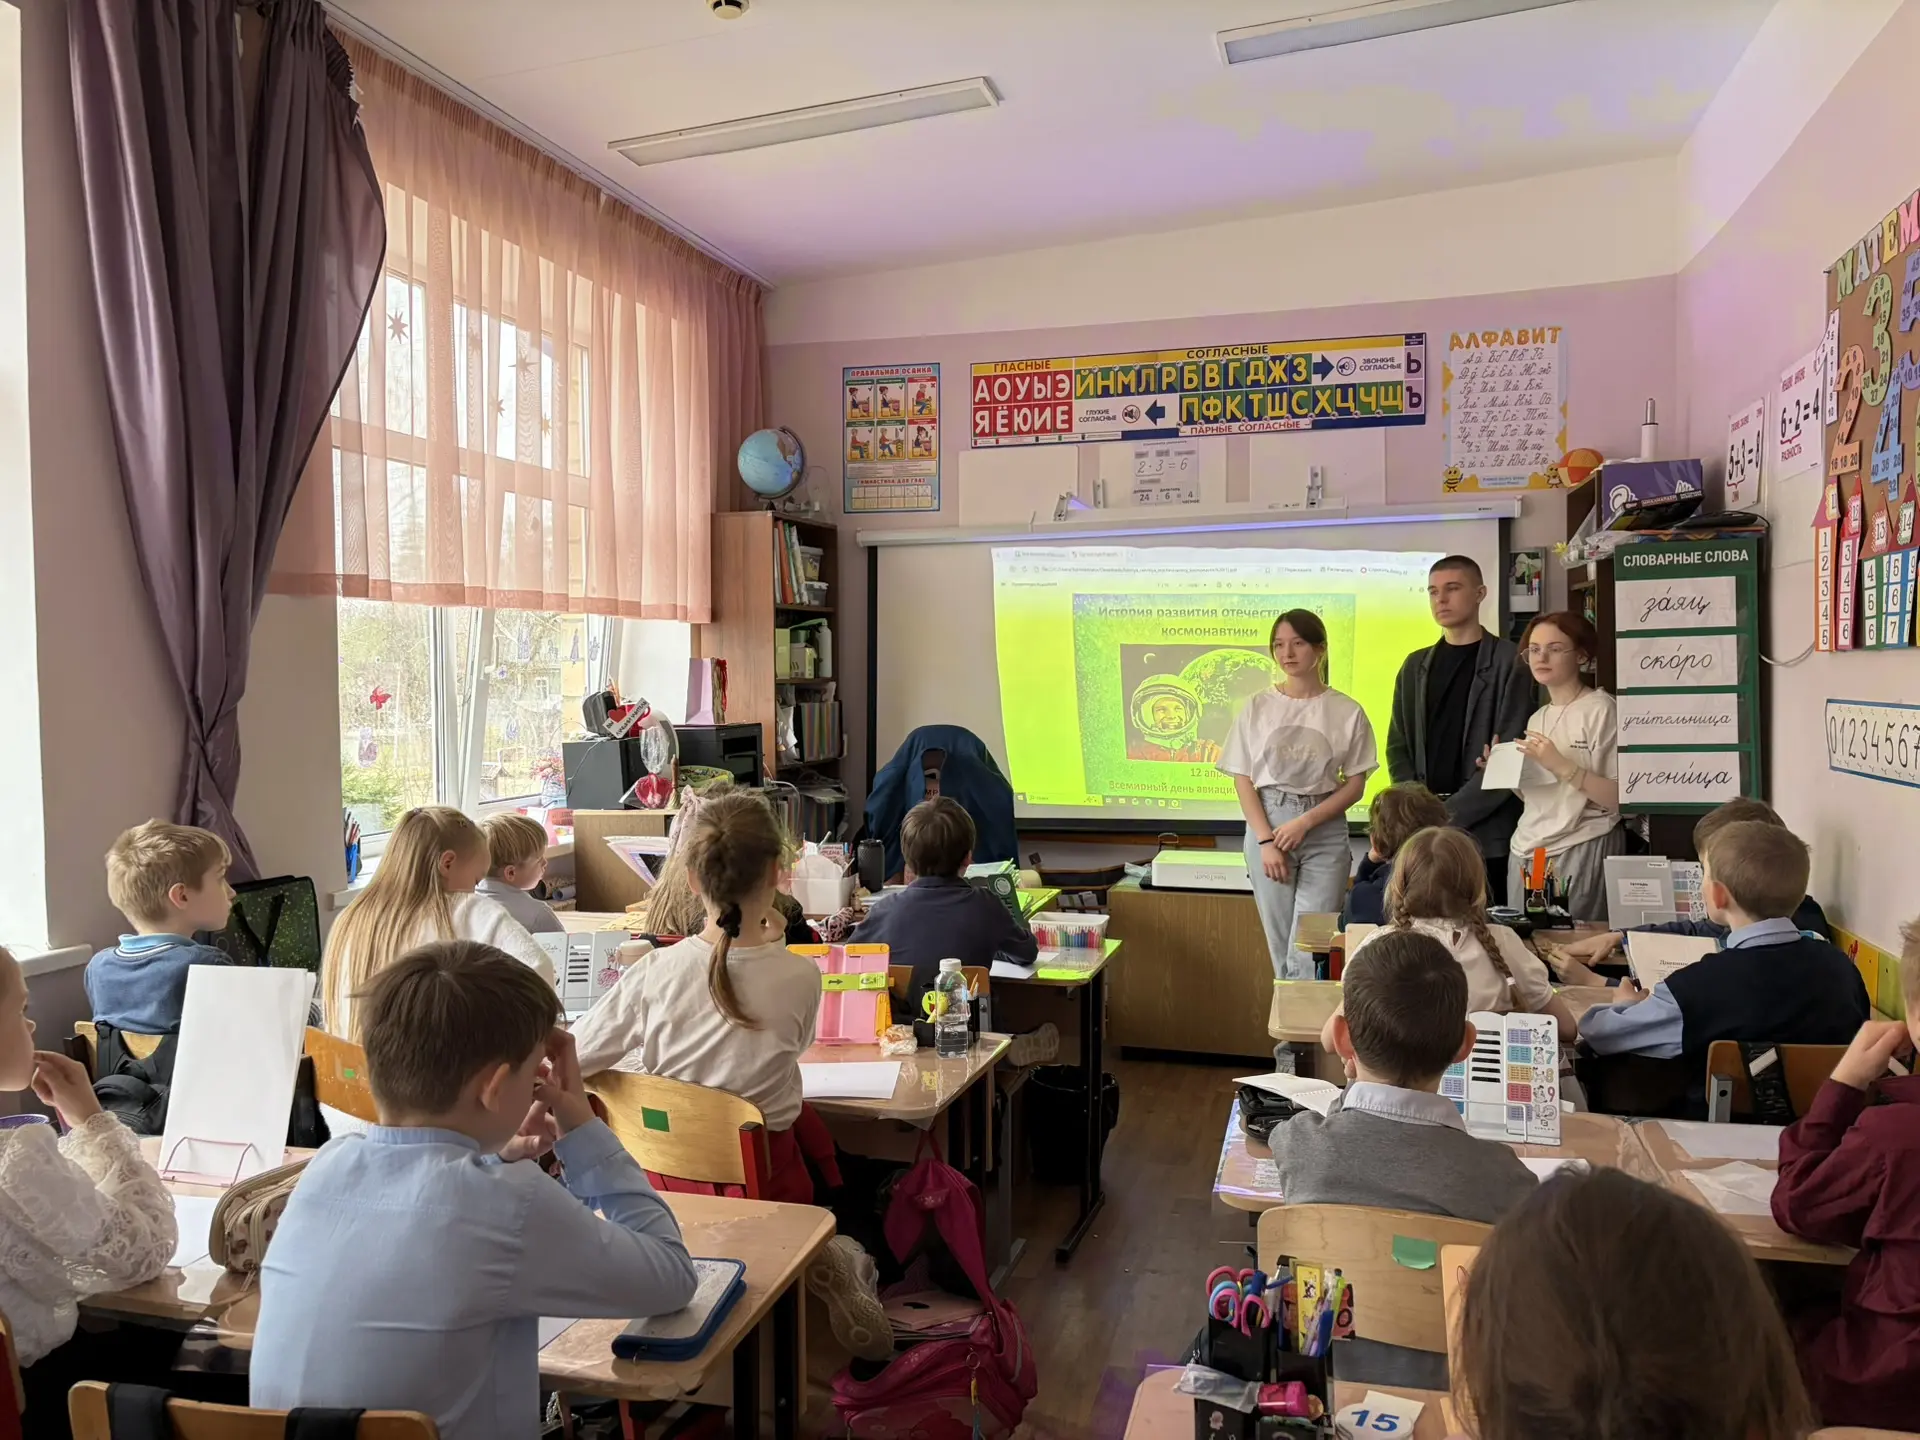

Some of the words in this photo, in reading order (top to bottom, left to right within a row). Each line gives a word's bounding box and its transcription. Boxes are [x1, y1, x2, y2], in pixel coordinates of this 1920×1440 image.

[1836, 190, 1920, 302] МАТЕМ
[1449, 326, 1562, 351] АЛФАВИТ
[1187, 345, 1268, 359] СОГЛАСНЫЕ
[851, 369, 900, 377] ПРАВИЛЬНАЯ
[994, 360, 1051, 373] ГЛАСНЫЕ
[1359, 363, 1402, 371] СОГЛАСНЫЕ
[1079, 414, 1116, 423] СОГЛАСНЫЕ
[1190, 425, 1232, 435] ПАРНЫЕ
[1238, 421, 1300, 432] СОГЛАСНЫЕ
[1903, 512, 1912, 531] 14
[1876, 521, 1885, 541] 13
[1823, 532, 1828, 547] 1
[1623, 552, 1702, 567] СЛОВАРНЫЕ
[1705, 549, 1749, 563] СЛОВА
[1844, 544, 1851, 561] 3
[1821, 558, 1829, 572] 2
[1867, 564, 1874, 582] 4
[1893, 558, 1900, 577] 5
[1843, 570, 1850, 587] 4
[1821, 580, 1829, 596] 3
[1868, 593, 1874, 611] 5
[1891, 588, 1899, 606] 6
[1098, 606, 1152, 618] История
[1157, 607, 1218, 619] развития
[1222, 605, 1324, 618] отечествей
[1821, 606, 1828, 620] 4
[1843, 597, 1850, 614] 5
[1161, 627, 1258, 638] космонавтики
[1822, 629, 1828, 645] 5
[1842, 623, 1849, 640] 6
[1868, 624, 1875, 640] 6
[1890, 621, 1897, 639] 7
[1191, 768, 1202, 777] 12
[1109, 781, 1168, 793] Всемирный
[1170, 785, 1194, 794] день
[1351, 1409, 1400, 1433] 15
